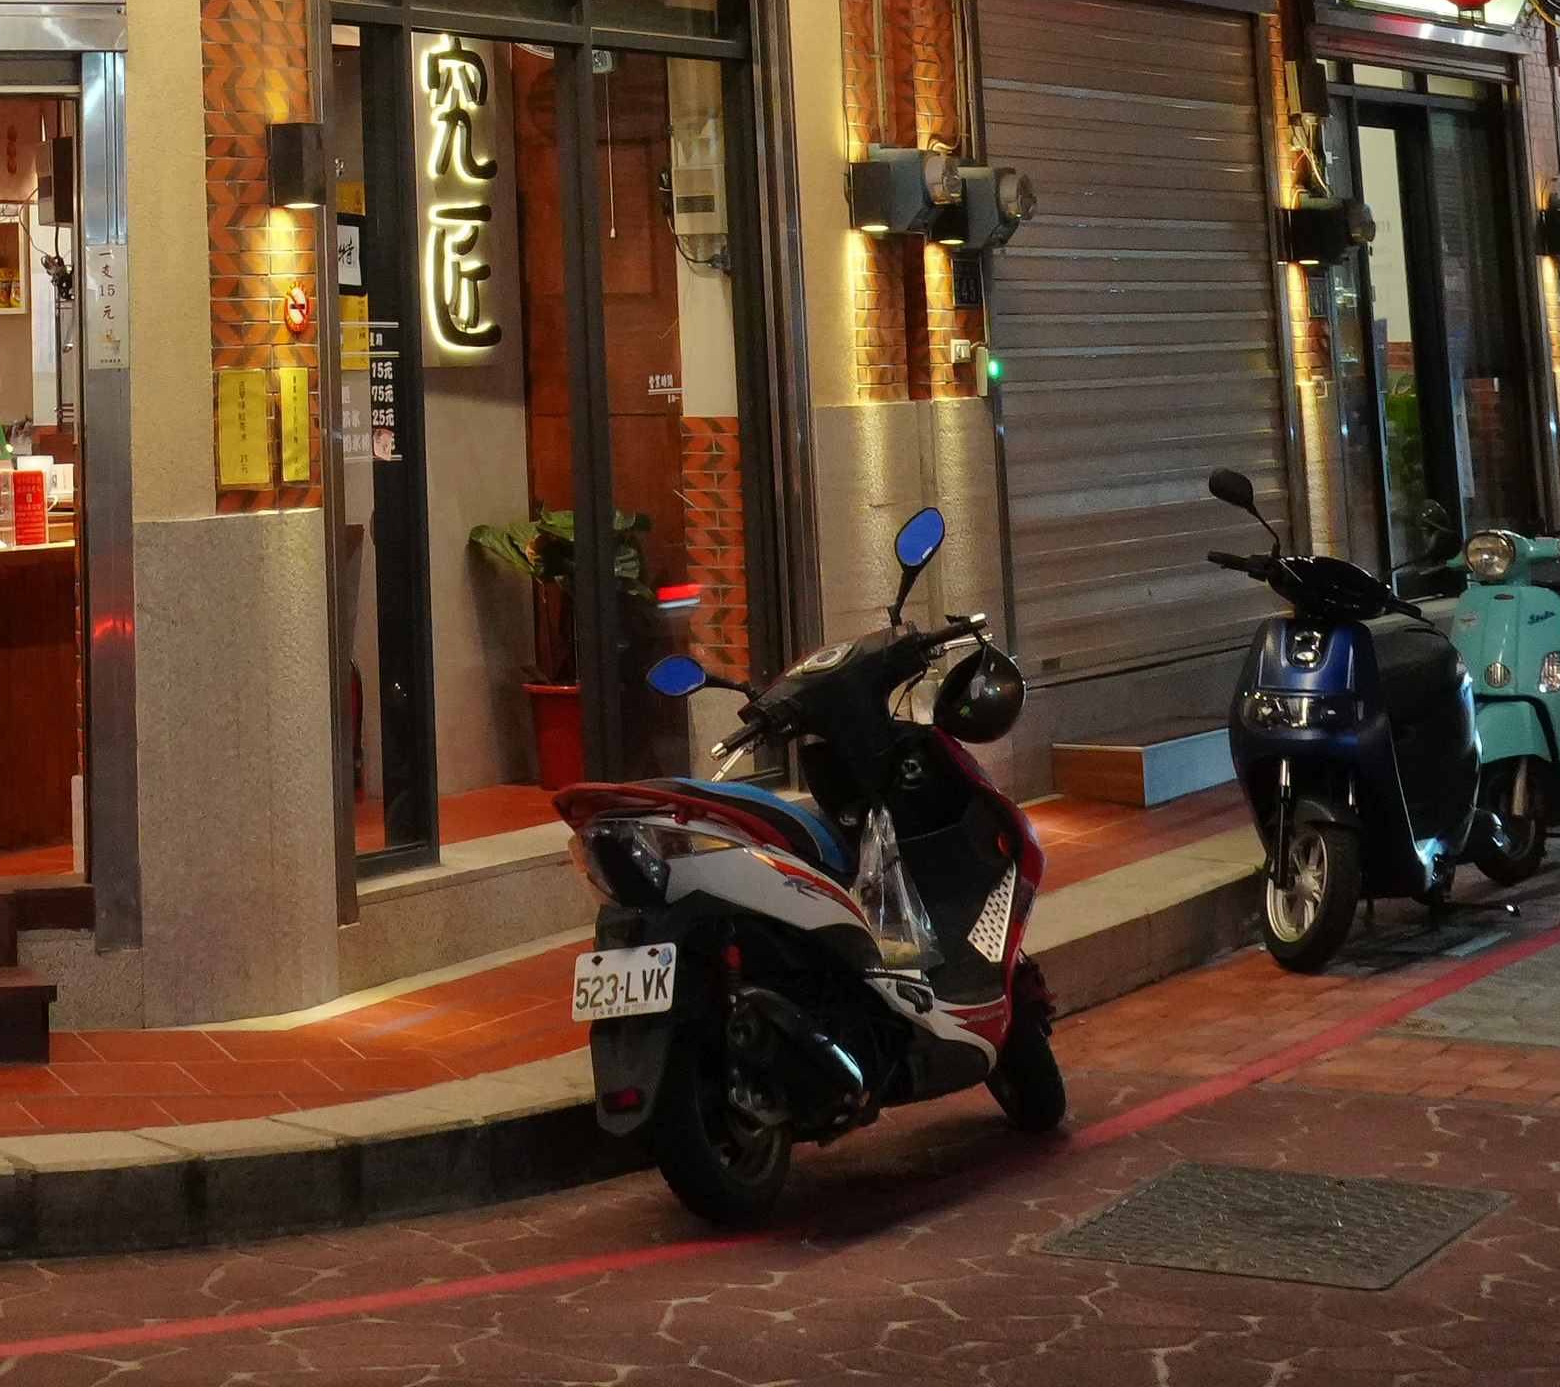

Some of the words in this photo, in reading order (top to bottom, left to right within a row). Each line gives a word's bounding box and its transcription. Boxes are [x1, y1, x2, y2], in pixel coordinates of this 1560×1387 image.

[371, 361, 393, 380] 15元
[371, 385, 394, 403] 75元
[372, 408, 395, 427] 25元
